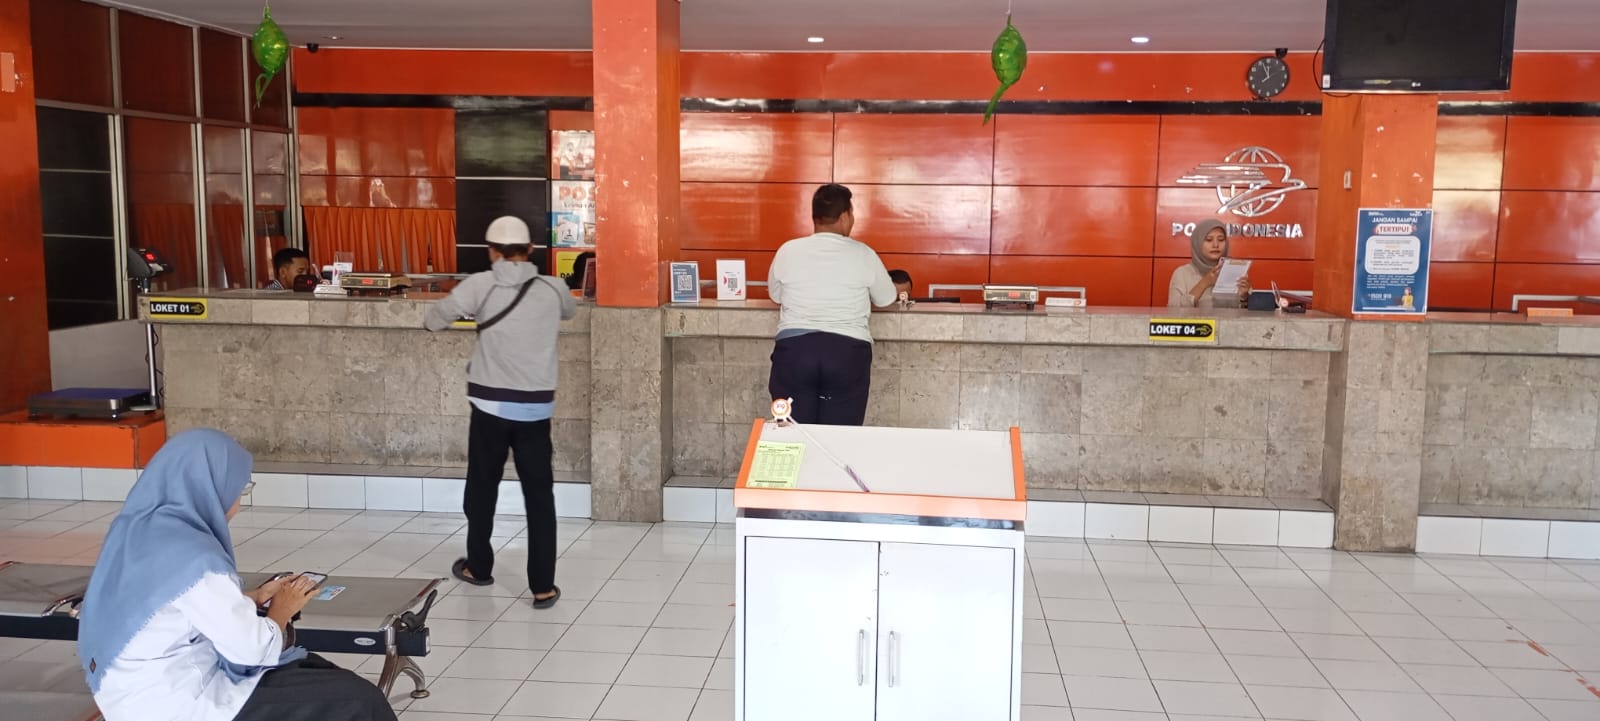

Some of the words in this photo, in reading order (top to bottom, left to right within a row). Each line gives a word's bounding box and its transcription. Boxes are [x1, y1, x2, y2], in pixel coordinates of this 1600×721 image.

[1172, 222, 1196, 237] PO
[1225, 223, 1304, 238] DONESIA
[151, 303, 178, 312] LOKET
[180, 304, 190, 313] 01
[1151, 325, 1181, 334] LOKET
[1184, 326, 1196, 335] 04
